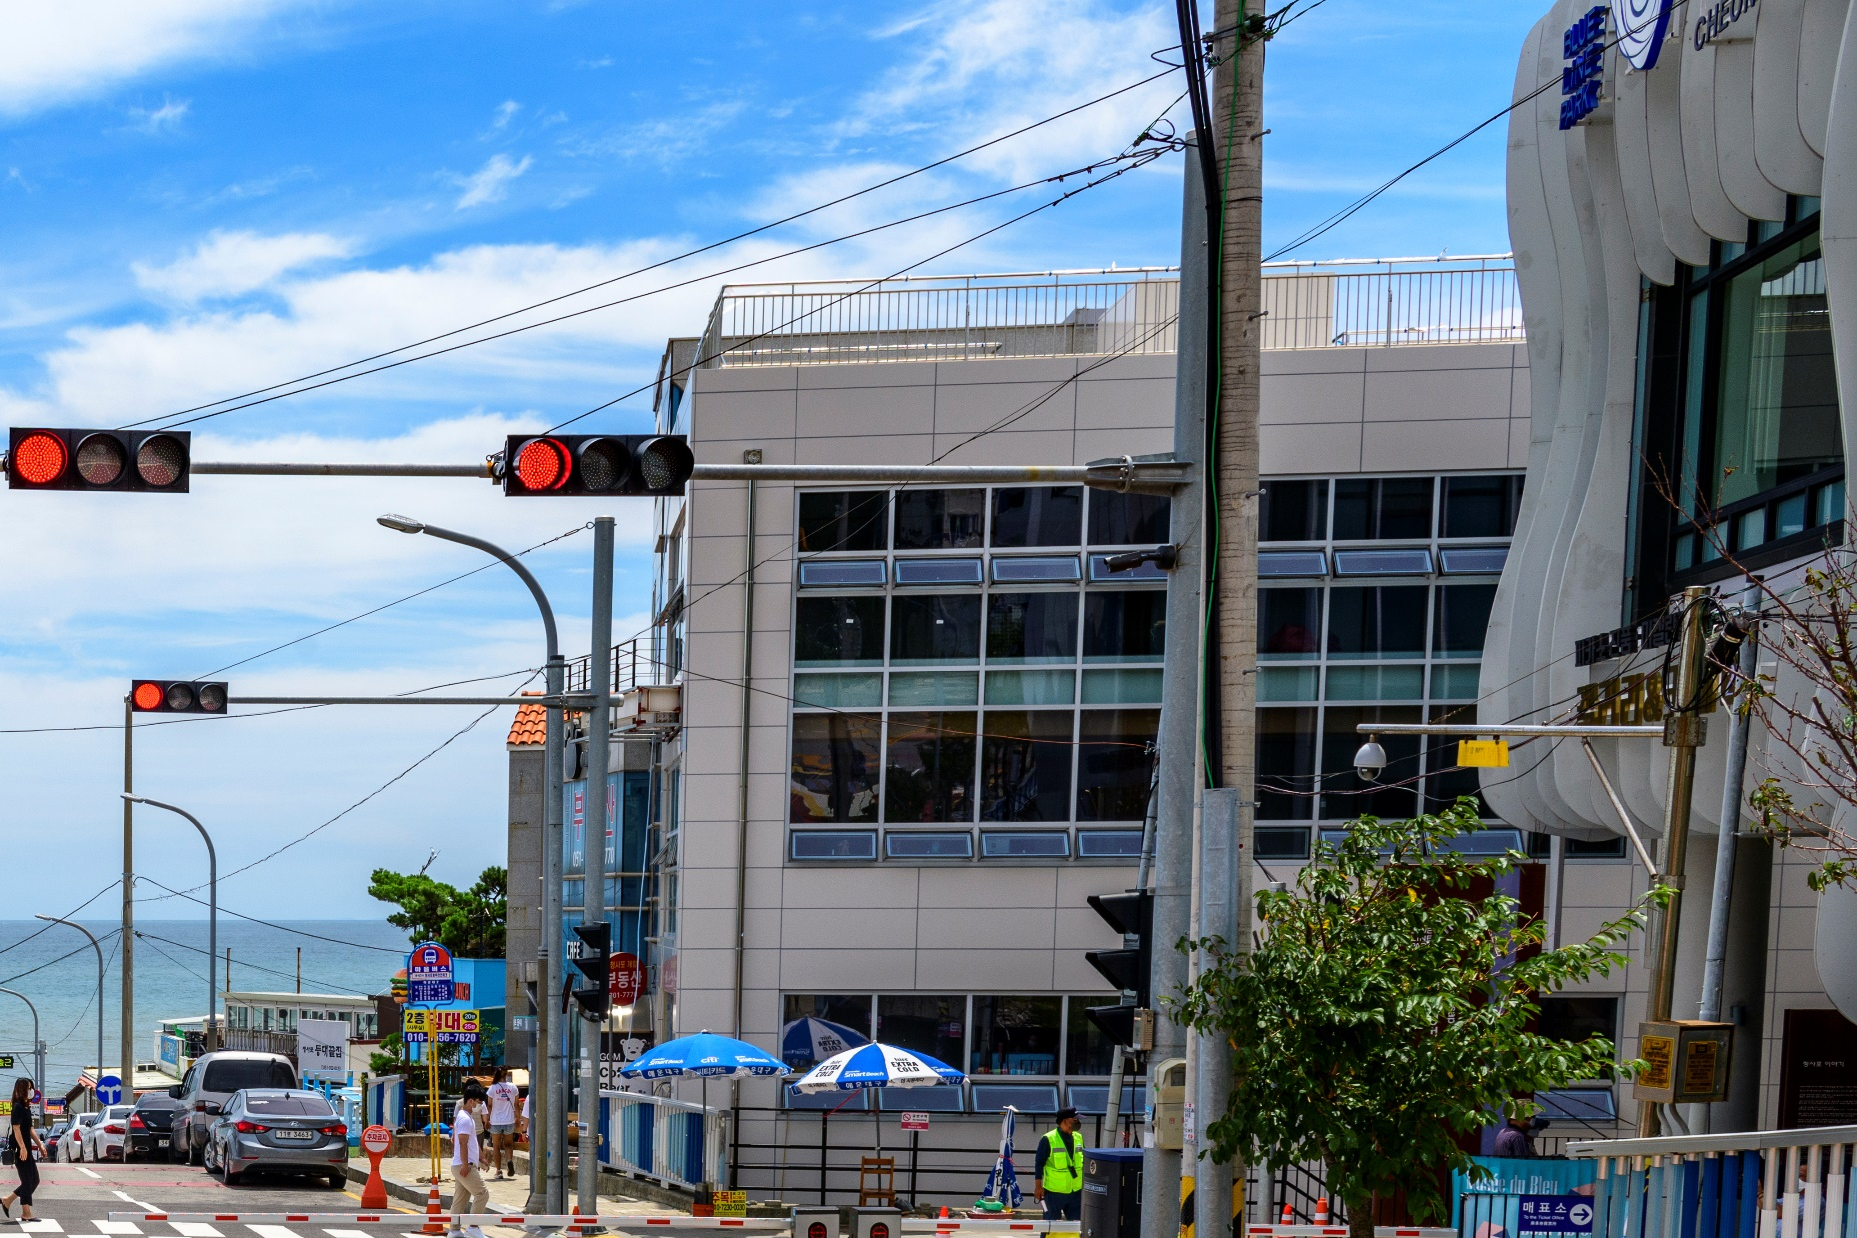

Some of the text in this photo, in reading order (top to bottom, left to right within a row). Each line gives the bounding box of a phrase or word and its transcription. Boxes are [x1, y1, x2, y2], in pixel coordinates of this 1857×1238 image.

[1563, 5, 1606, 60] BLUE
[1562, 42, 1605, 95] LINE
[1559, 79, 1602, 131] PARK
[566, 941, 583, 960] CAFE
[406, 1012, 425, 1025] 2층
[407, 1032, 477, 1042] 010-56-7620
[820, 1064, 842, 1072] EXTRA
[367, 1133, 388, 1141] 주차금지
[1510, 1175, 1525, 1194] du
[1529, 1175, 1558, 1195] Bleu
[713, 1203, 746, 1212] 10-7230-0030
